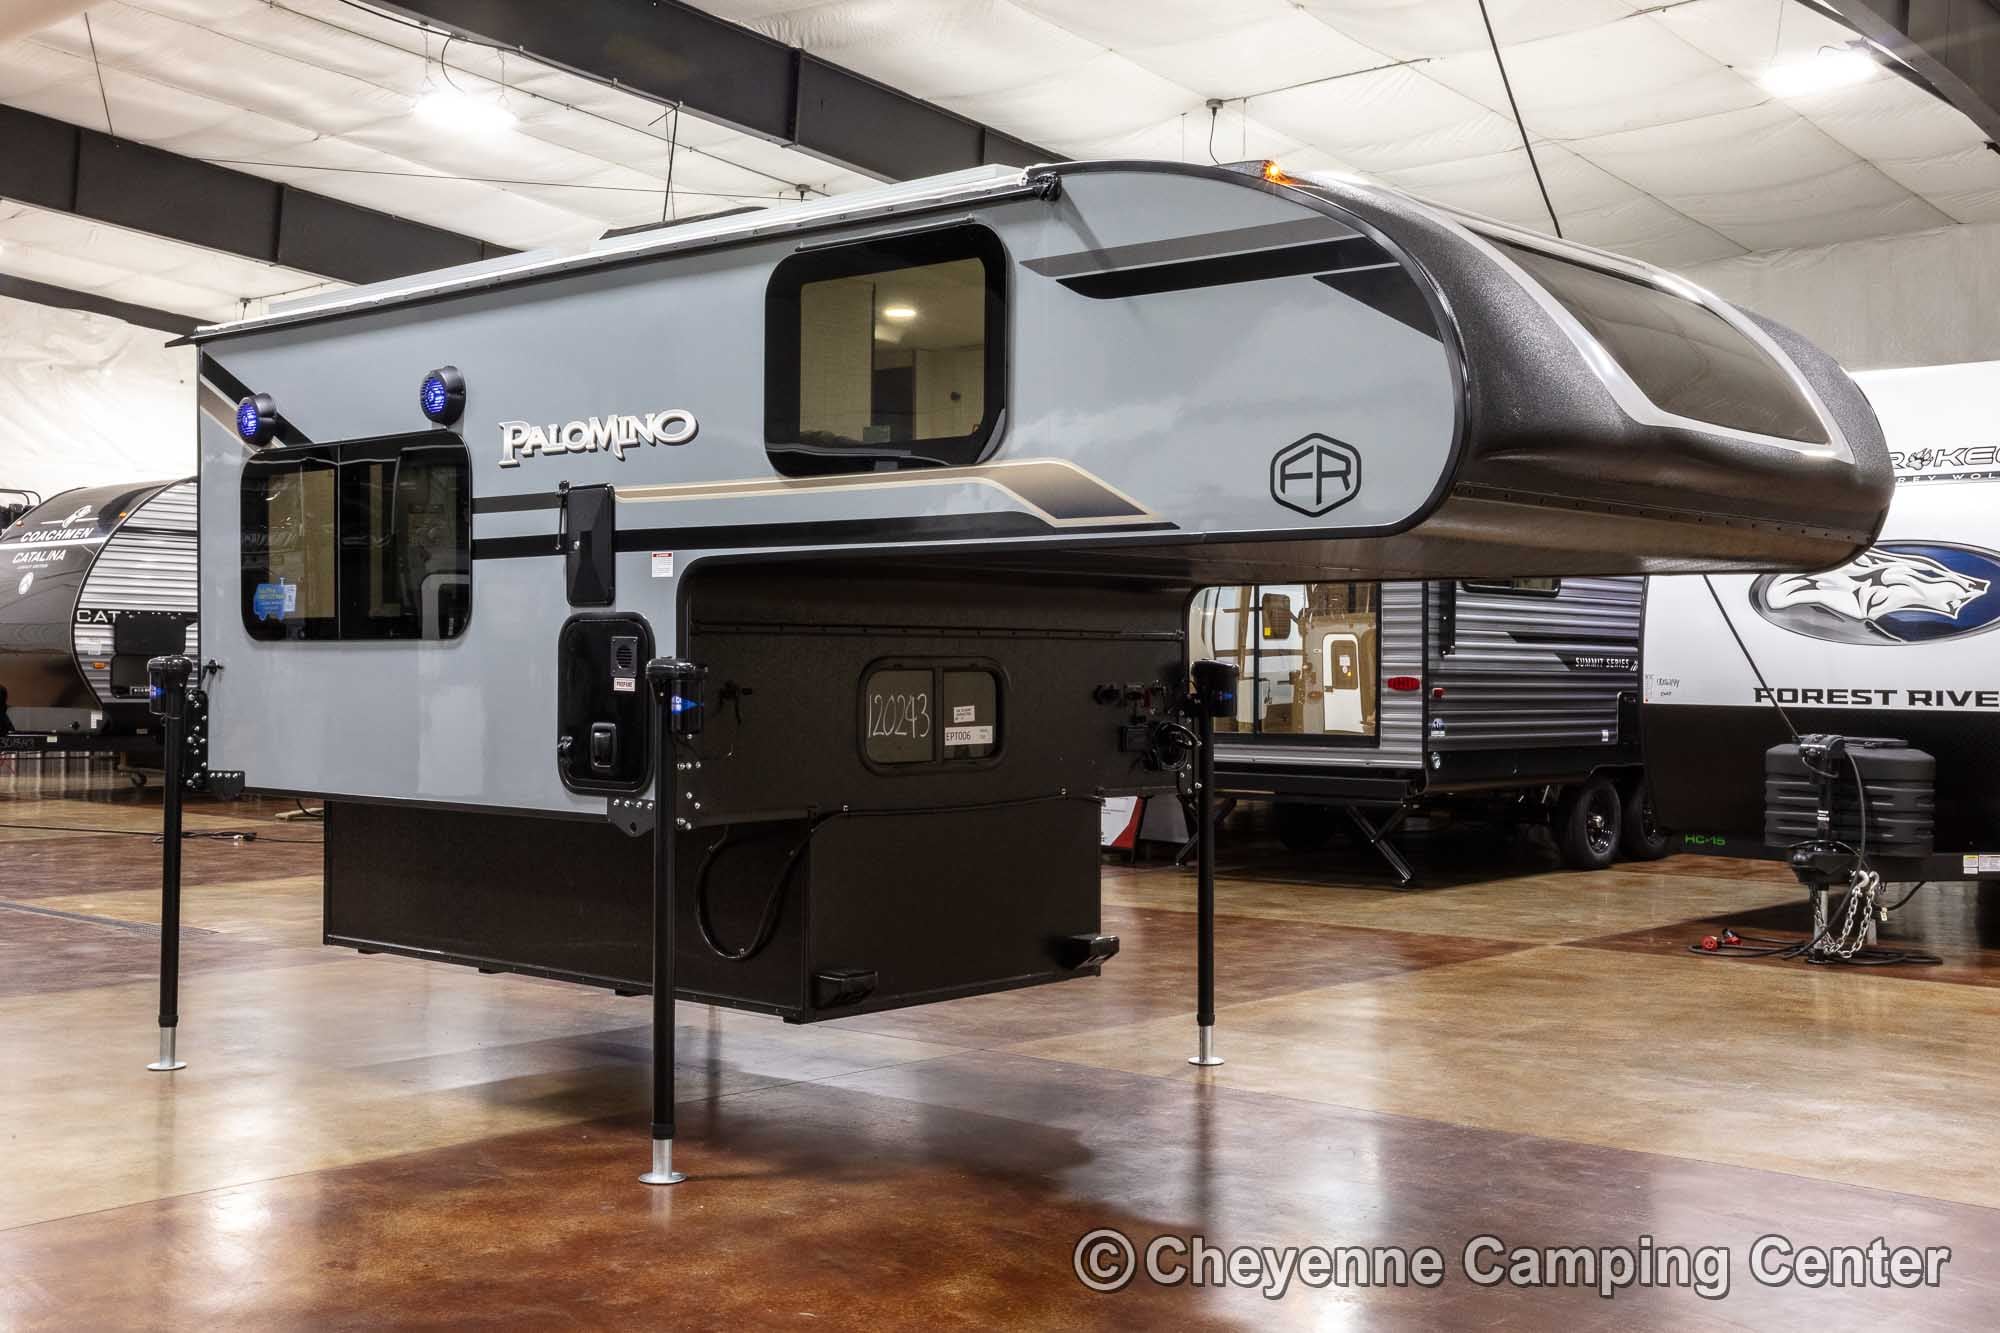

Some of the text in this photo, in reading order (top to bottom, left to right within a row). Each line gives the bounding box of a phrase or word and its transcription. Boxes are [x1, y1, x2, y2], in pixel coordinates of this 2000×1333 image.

[20, 527, 94, 542] COACHMEN
[12, 549, 67, 564] CATALINA
[76, 608, 121, 623] CAT
[1575, 657, 1630, 668] SUMMIT SERIES
[1753, 687, 2000, 707] FOREST RIVE
[867, 693, 931, 739] 120243
